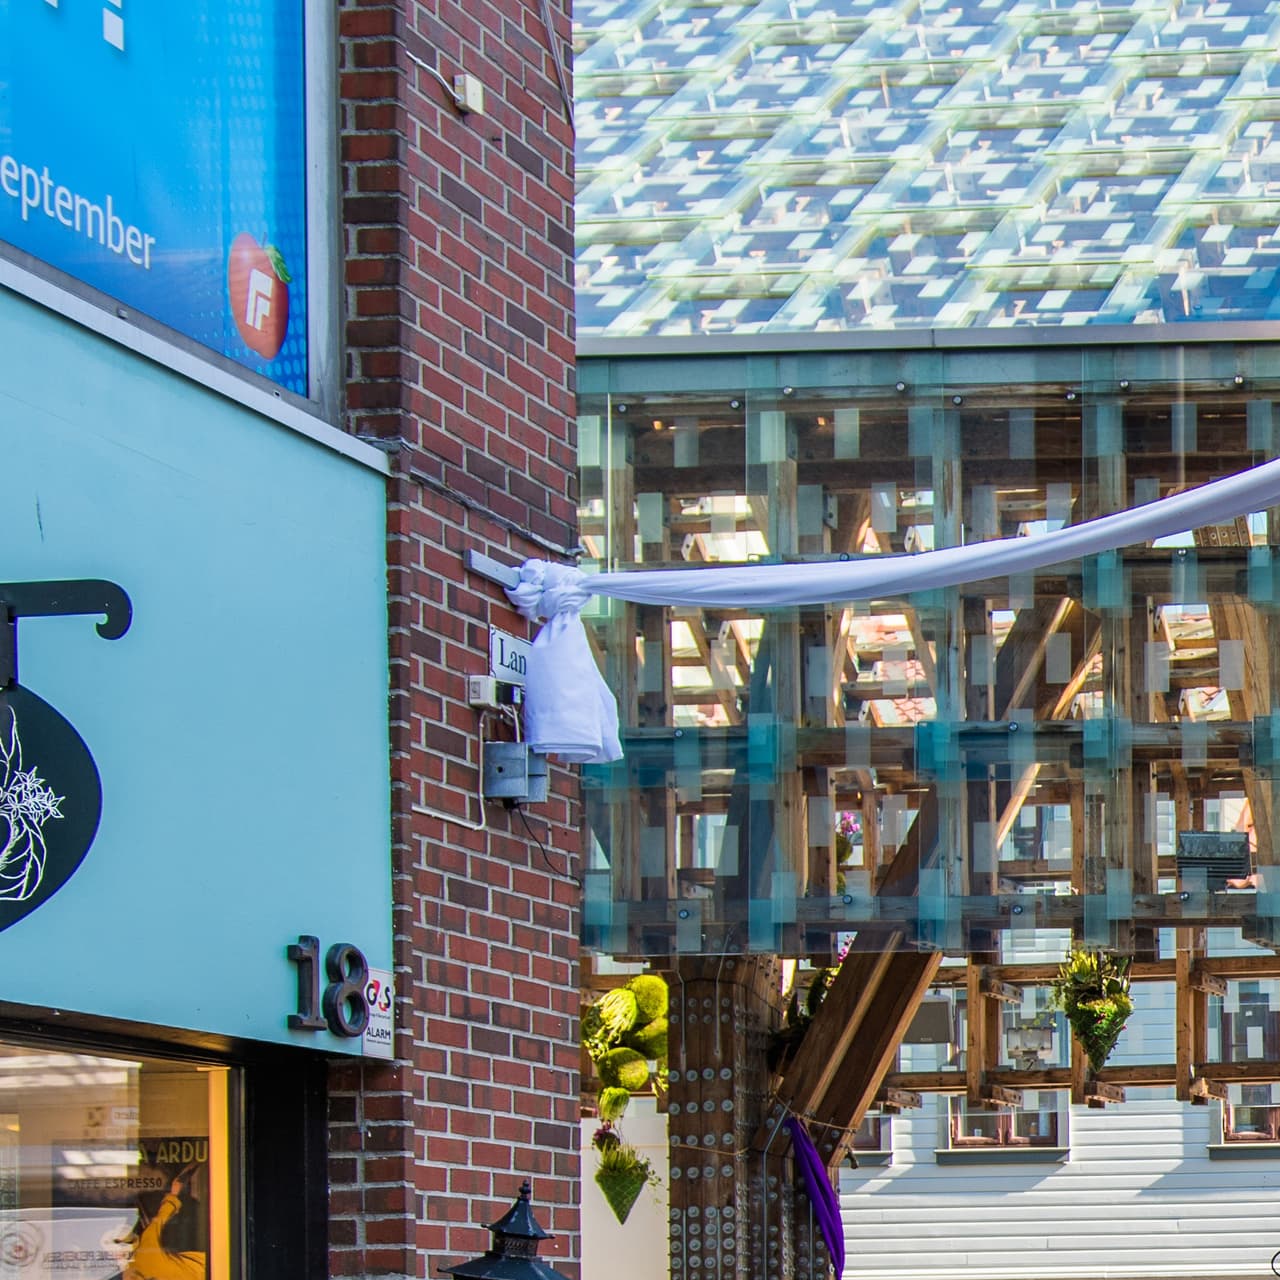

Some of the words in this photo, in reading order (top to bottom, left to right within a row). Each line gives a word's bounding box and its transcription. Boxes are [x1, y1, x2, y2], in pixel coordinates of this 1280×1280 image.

[0, 154, 155, 269] eptember
[499, 637, 527, 675] Lan
[287, 935, 370, 1037] 18
[366, 1026, 391, 1040] ALARM
